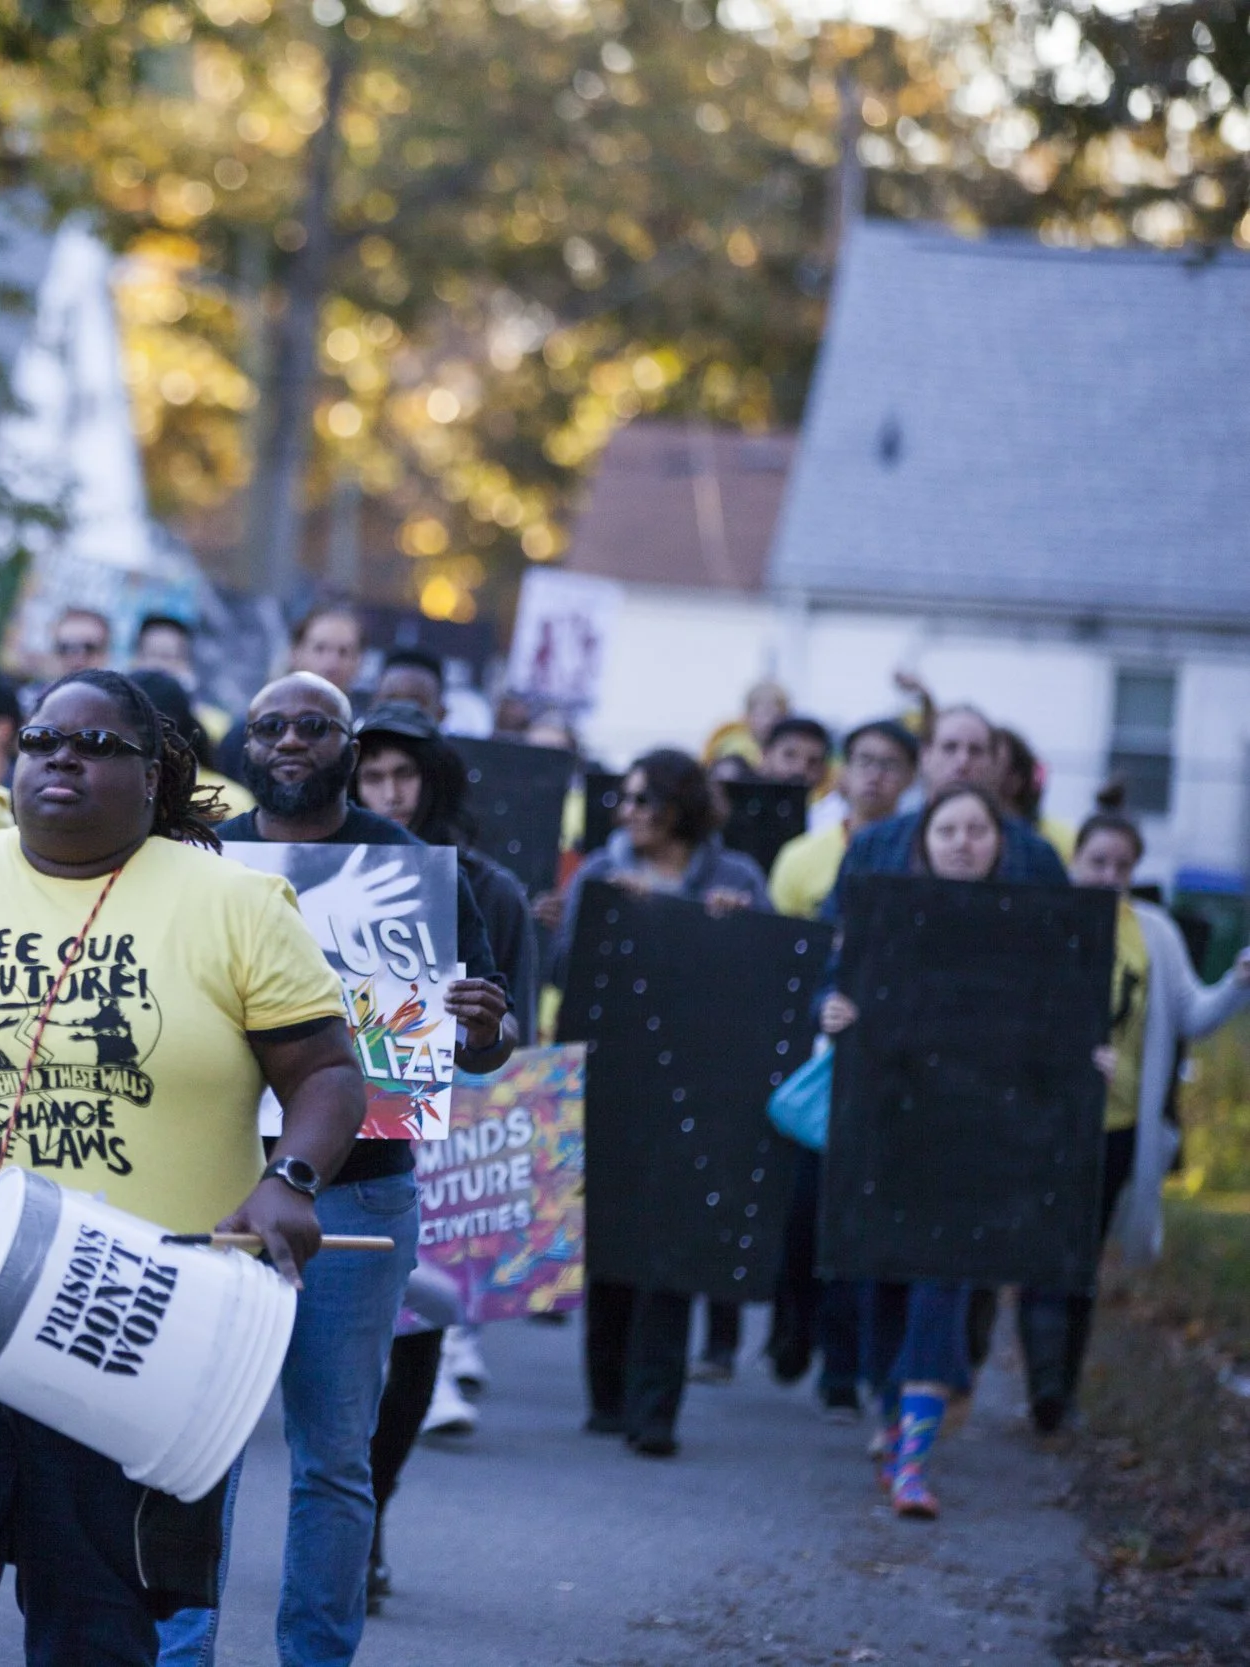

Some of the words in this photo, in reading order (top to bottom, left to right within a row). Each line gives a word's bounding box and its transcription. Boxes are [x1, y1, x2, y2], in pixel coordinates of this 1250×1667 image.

[57, 934, 137, 965] OUR
[328, 915, 440, 984] US!
[49, 1066, 97, 1090] THESE
[99, 1068, 149, 1099] WALLS
[28, 1129, 134, 1177] LAWS
[416, 1107, 535, 1177] MINDS
[34, 1224, 108, 1352] PRISONS
[67, 1239, 143, 1369] DON'T
[102, 1256, 178, 1378] WORK
